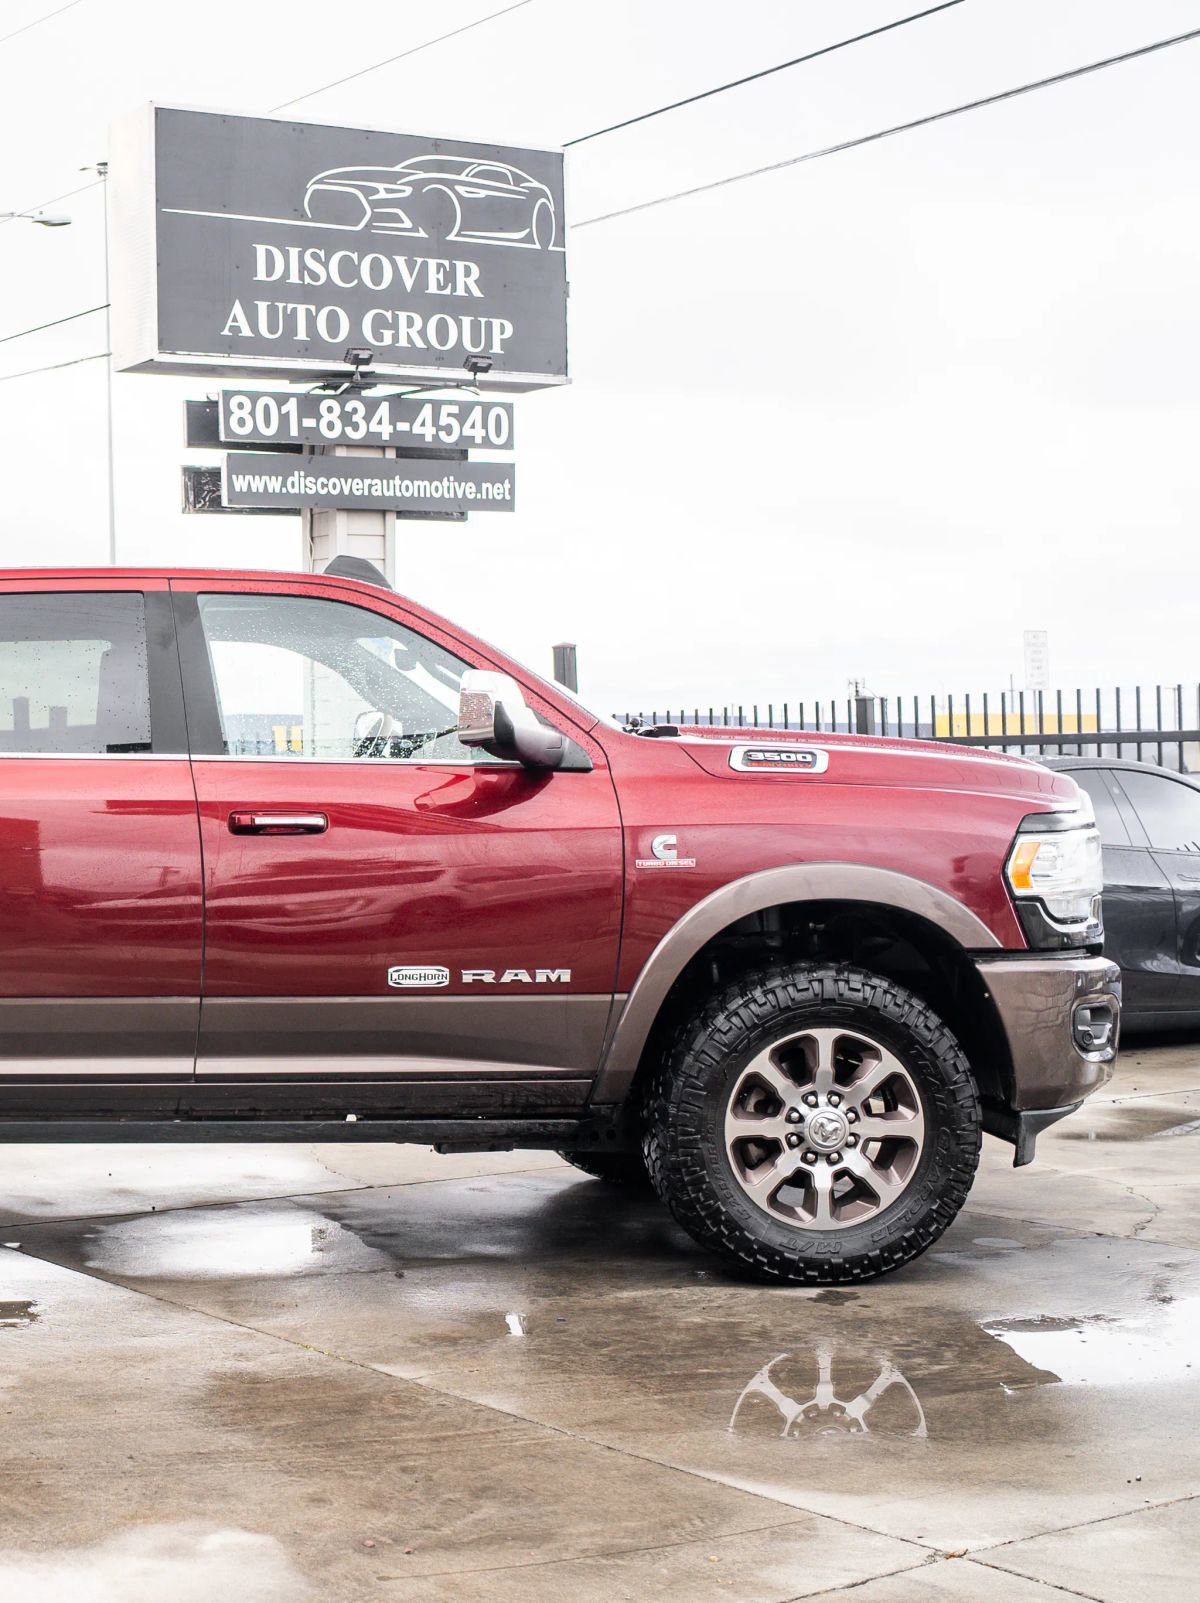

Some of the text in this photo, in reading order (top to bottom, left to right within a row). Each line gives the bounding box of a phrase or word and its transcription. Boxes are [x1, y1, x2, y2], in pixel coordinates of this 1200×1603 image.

[252, 243, 485, 298] DISCOVER
[221, 299, 514, 354] AUTO GROUP
[229, 395, 509, 445] 801-834-4540
[231, 471, 512, 500] www.discoverautomotive.net
[746, 751, 813, 762] 3500
[390, 969, 571, 983] LONGHORN RAM
